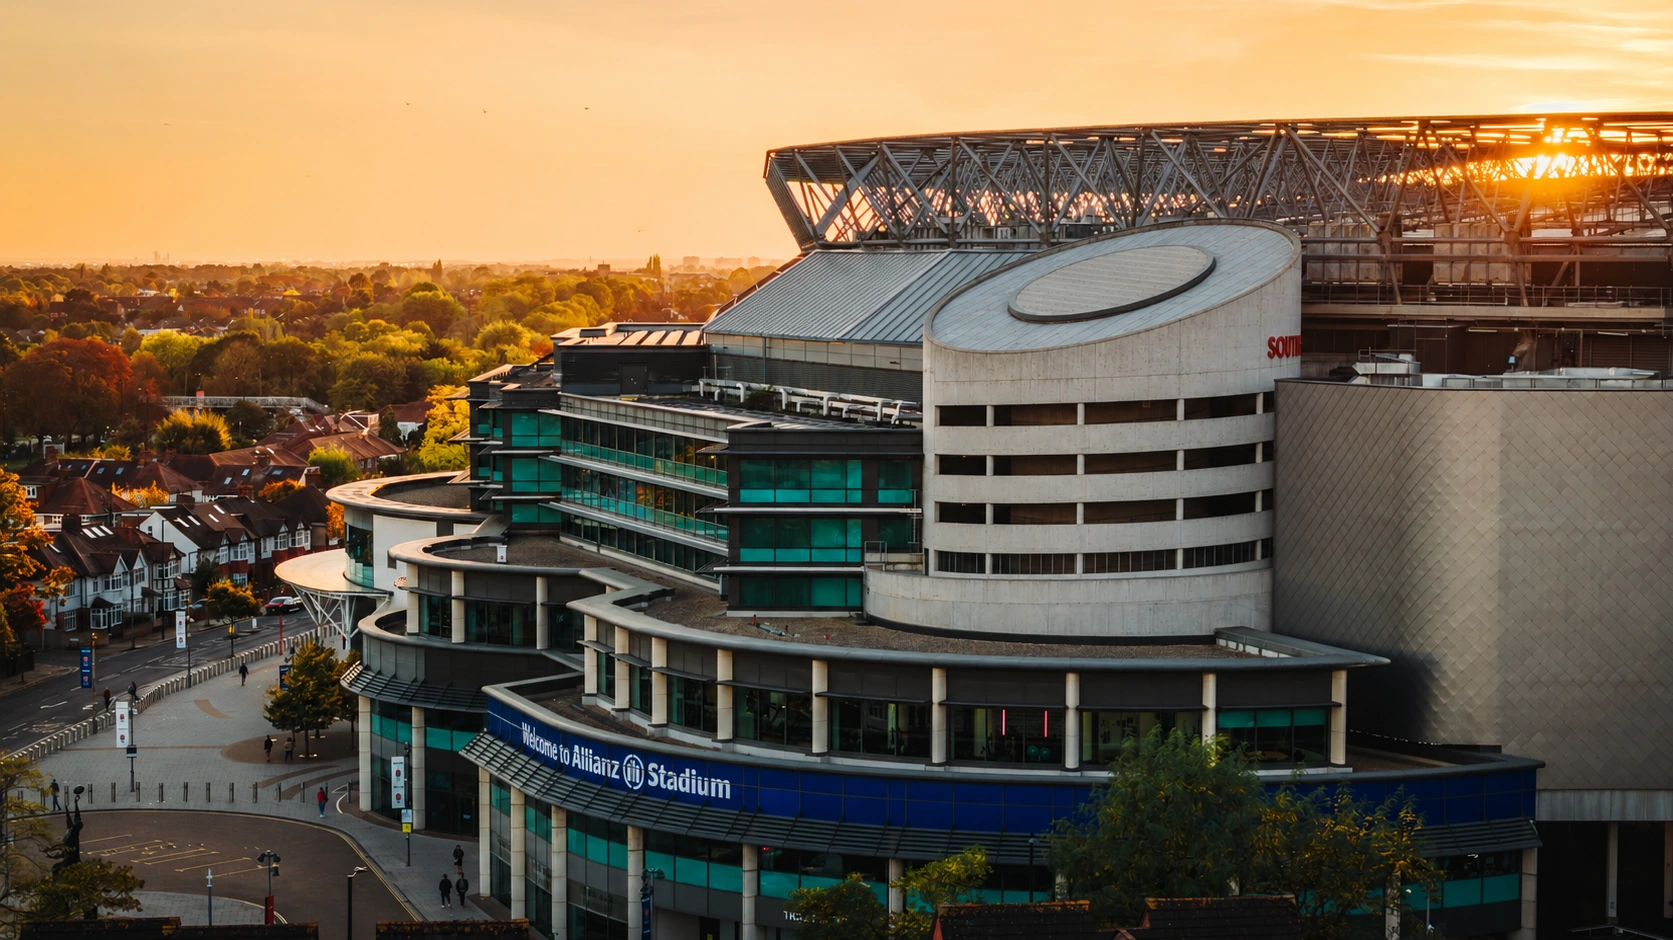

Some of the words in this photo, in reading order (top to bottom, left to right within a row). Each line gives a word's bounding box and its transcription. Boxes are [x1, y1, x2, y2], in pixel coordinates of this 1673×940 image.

[521, 721, 558, 761] Welcome
[559, 744, 570, 765] to
[572, 744, 620, 779] Allianz
[647, 762, 731, 799] Stadium
